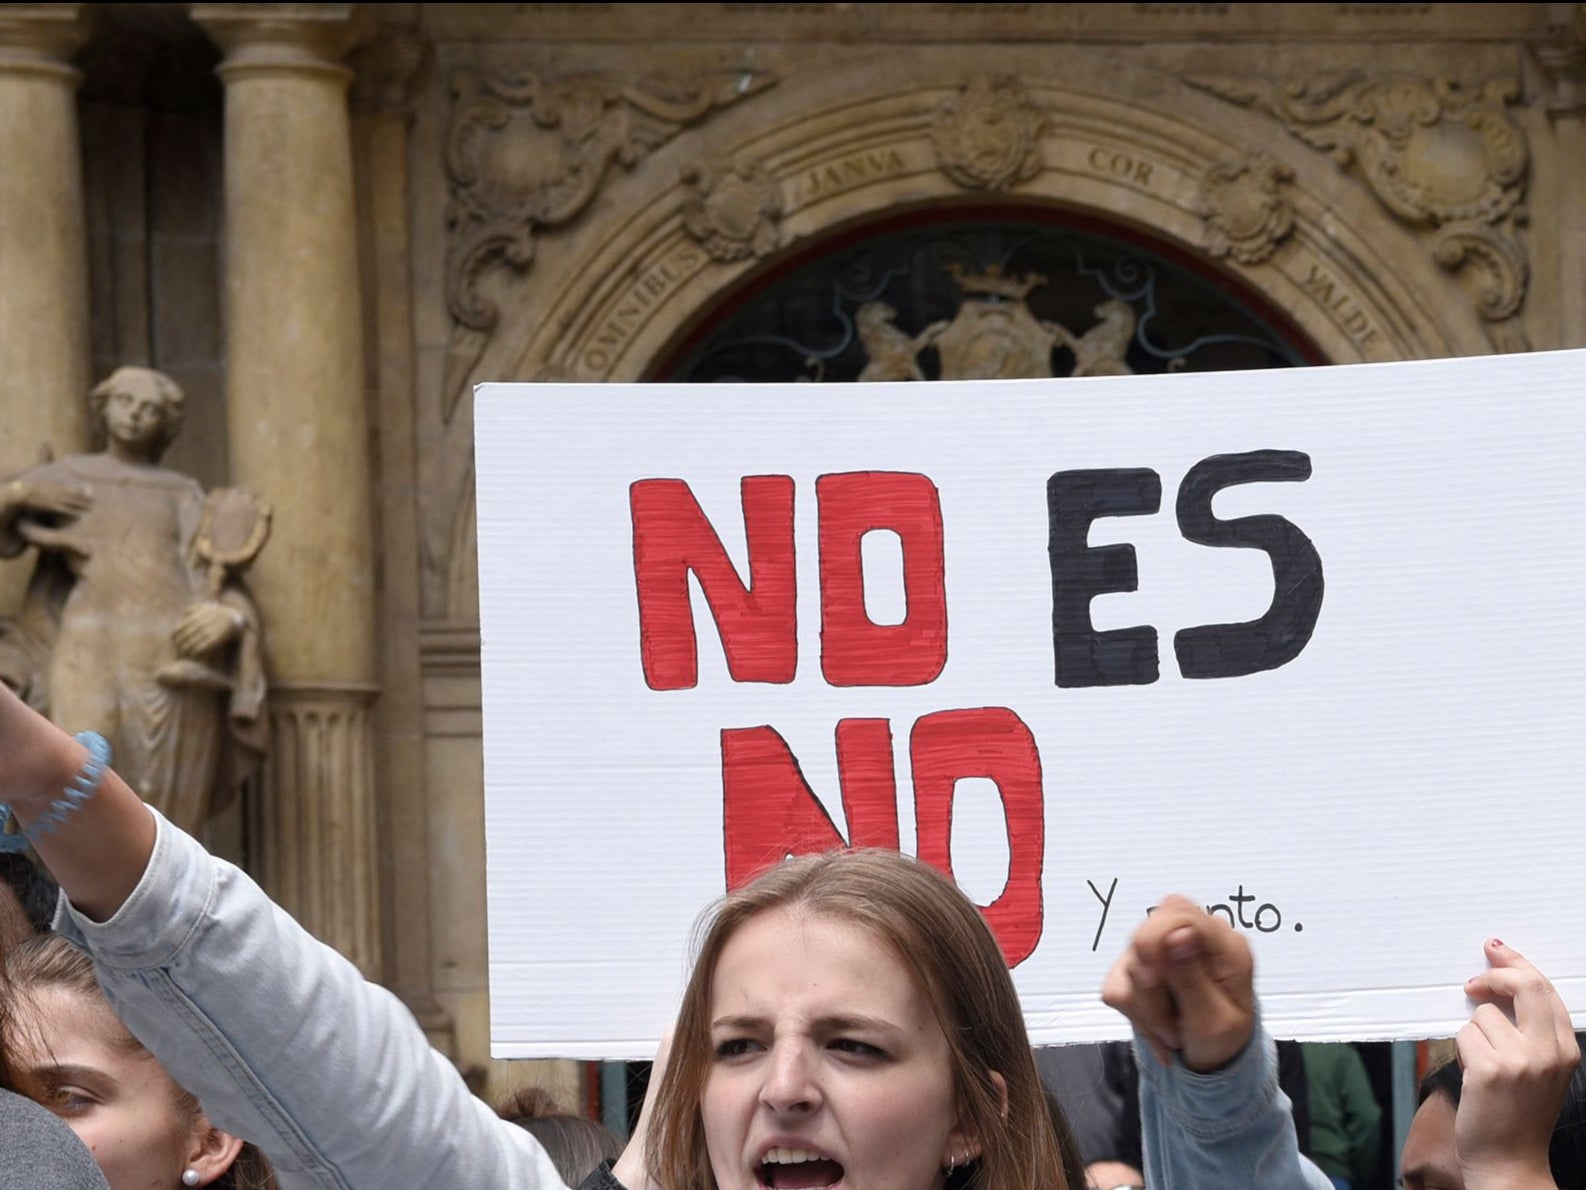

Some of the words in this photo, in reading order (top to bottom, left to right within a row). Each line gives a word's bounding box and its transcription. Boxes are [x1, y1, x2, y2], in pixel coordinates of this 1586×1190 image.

[1087, 147, 1154, 186] COR
[629, 469, 949, 690] NO
[1047, 449, 1326, 689] ES
[720, 706, 1045, 970] NO
[1146, 884, 1304, 934] nto.
